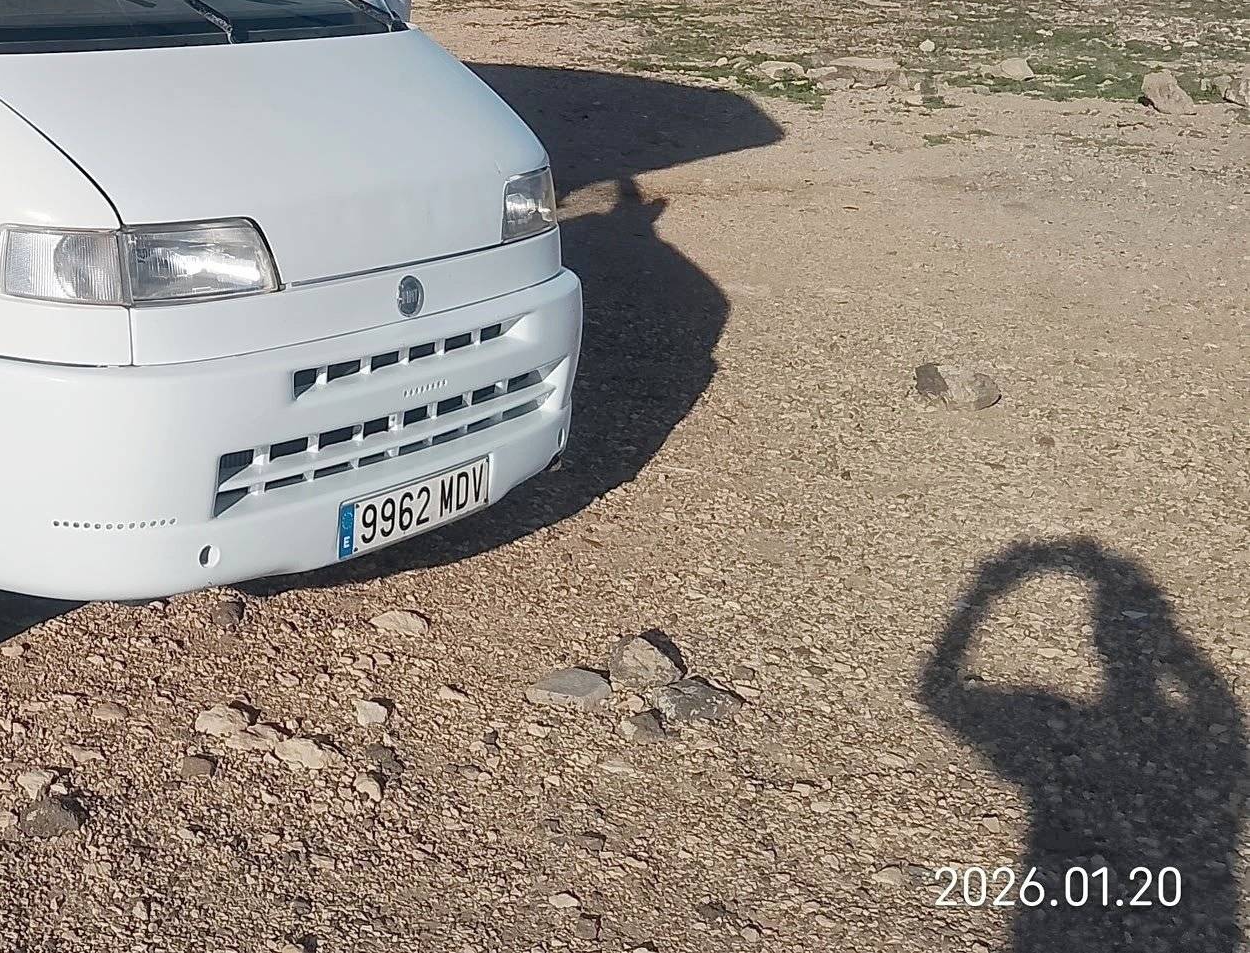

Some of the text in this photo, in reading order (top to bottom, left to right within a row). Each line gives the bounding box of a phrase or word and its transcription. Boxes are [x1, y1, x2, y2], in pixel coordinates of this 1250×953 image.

[361, 463, 484, 544] 9962 MDV
[343, 535, 351, 549] E
